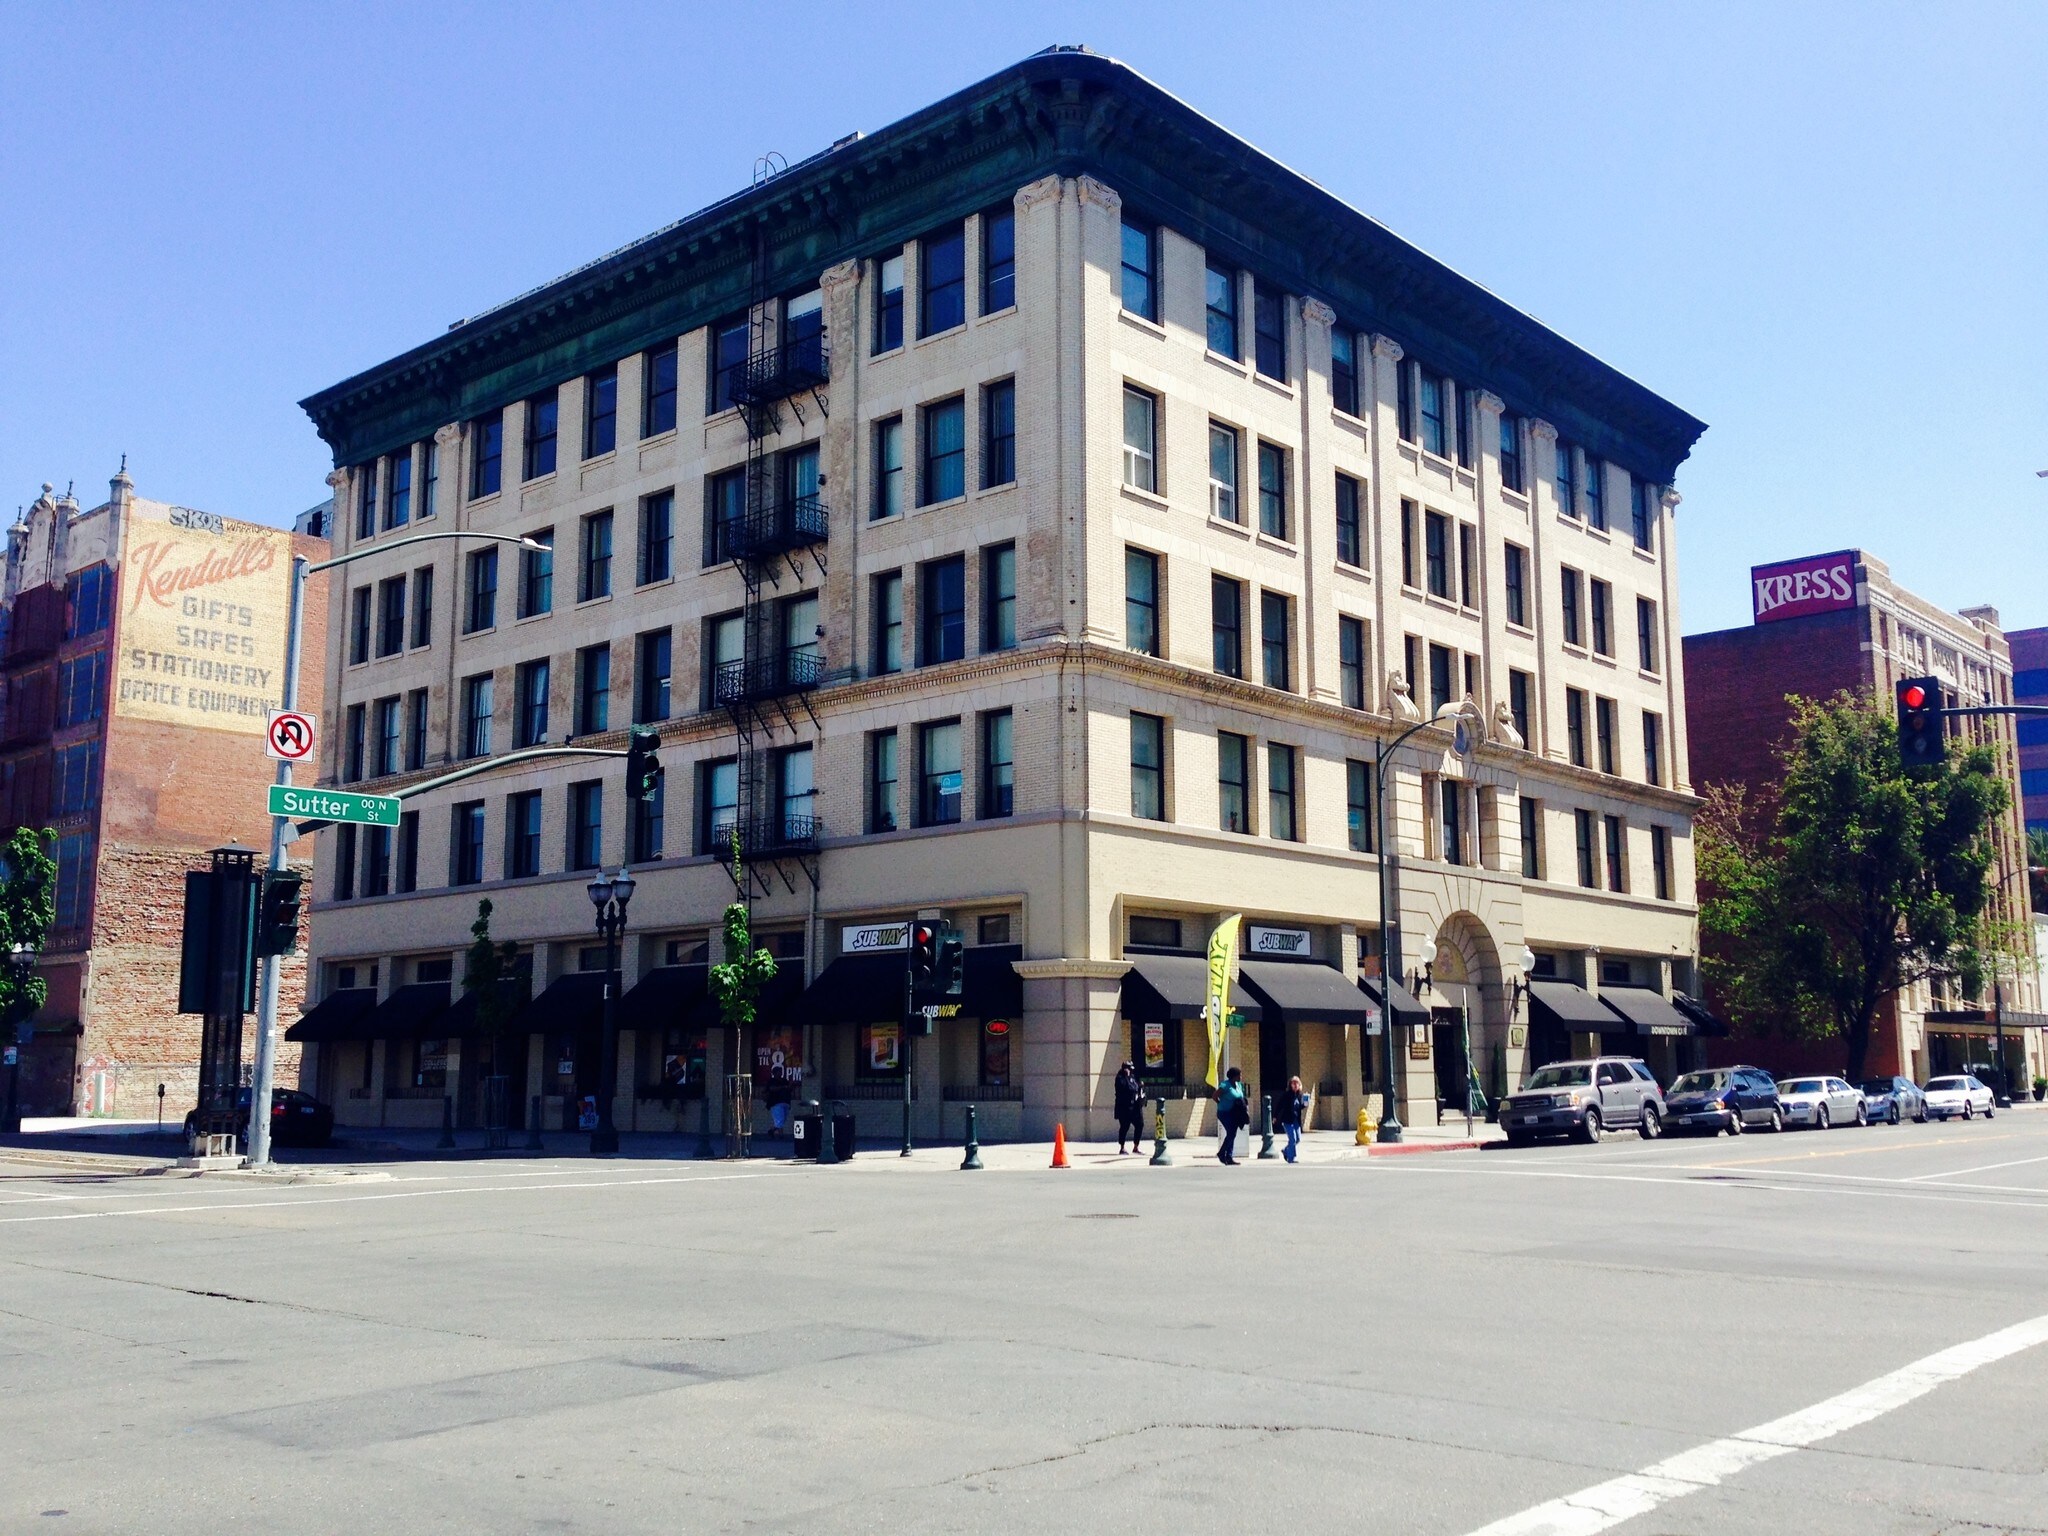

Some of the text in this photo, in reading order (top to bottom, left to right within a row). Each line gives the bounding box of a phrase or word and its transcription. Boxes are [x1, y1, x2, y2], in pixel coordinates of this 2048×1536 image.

[129, 537, 277, 616] Kendall's
[1754, 565, 1852, 616] KRESS
[182, 595, 252, 627] GIFTS
[176, 625, 254, 658] SAFES
[131, 649, 271, 689] STATIONERY
[120, 678, 181, 706] OFFICE
[283, 792, 350, 816] Sutter
[361, 799, 387, 810] 00 N
[367, 811, 379, 821] St
[853, 925, 908, 949] SUBWAY
[1259, 931, 1303, 951] SUBWAY
[922, 1004, 962, 1018] SUBWAY
[771, 1050, 785, 1078] 8
[786, 1067, 802, 1081] PM
